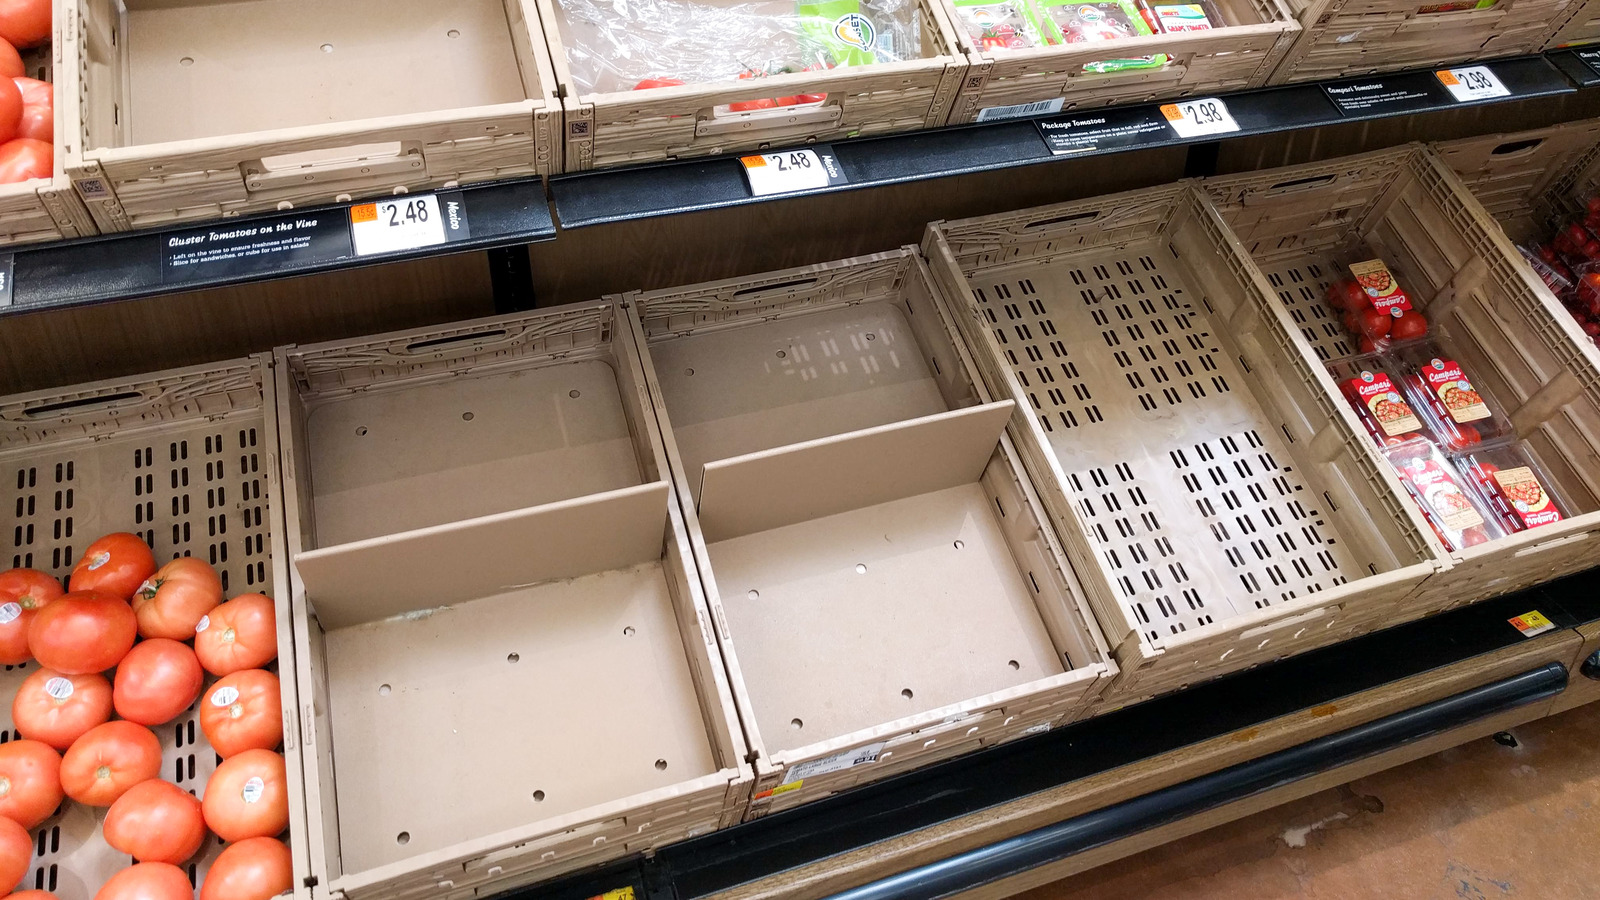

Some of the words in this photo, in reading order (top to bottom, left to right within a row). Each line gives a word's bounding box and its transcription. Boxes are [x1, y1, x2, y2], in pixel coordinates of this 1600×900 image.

[1072, 118, 1106, 126] Tomatoes
[822, 155, 838, 178] Mexico
[382, 200, 428, 226] $2.48
[447, 201, 461, 230] Mexico
[168, 236, 206, 247] Cluster
[208, 228, 258, 242] Tomatoes
[260, 226, 273, 234] on
[276, 222, 293, 232] the
[296, 219, 318, 229] Vine
[252, 240, 280, 248] freshness
[1375, 296, 1405, 309] Campari
[1429, 367, 1462, 382] Campari
[1359, 378, 1391, 394] Campari
[1525, 512, 1558, 527] Campari
